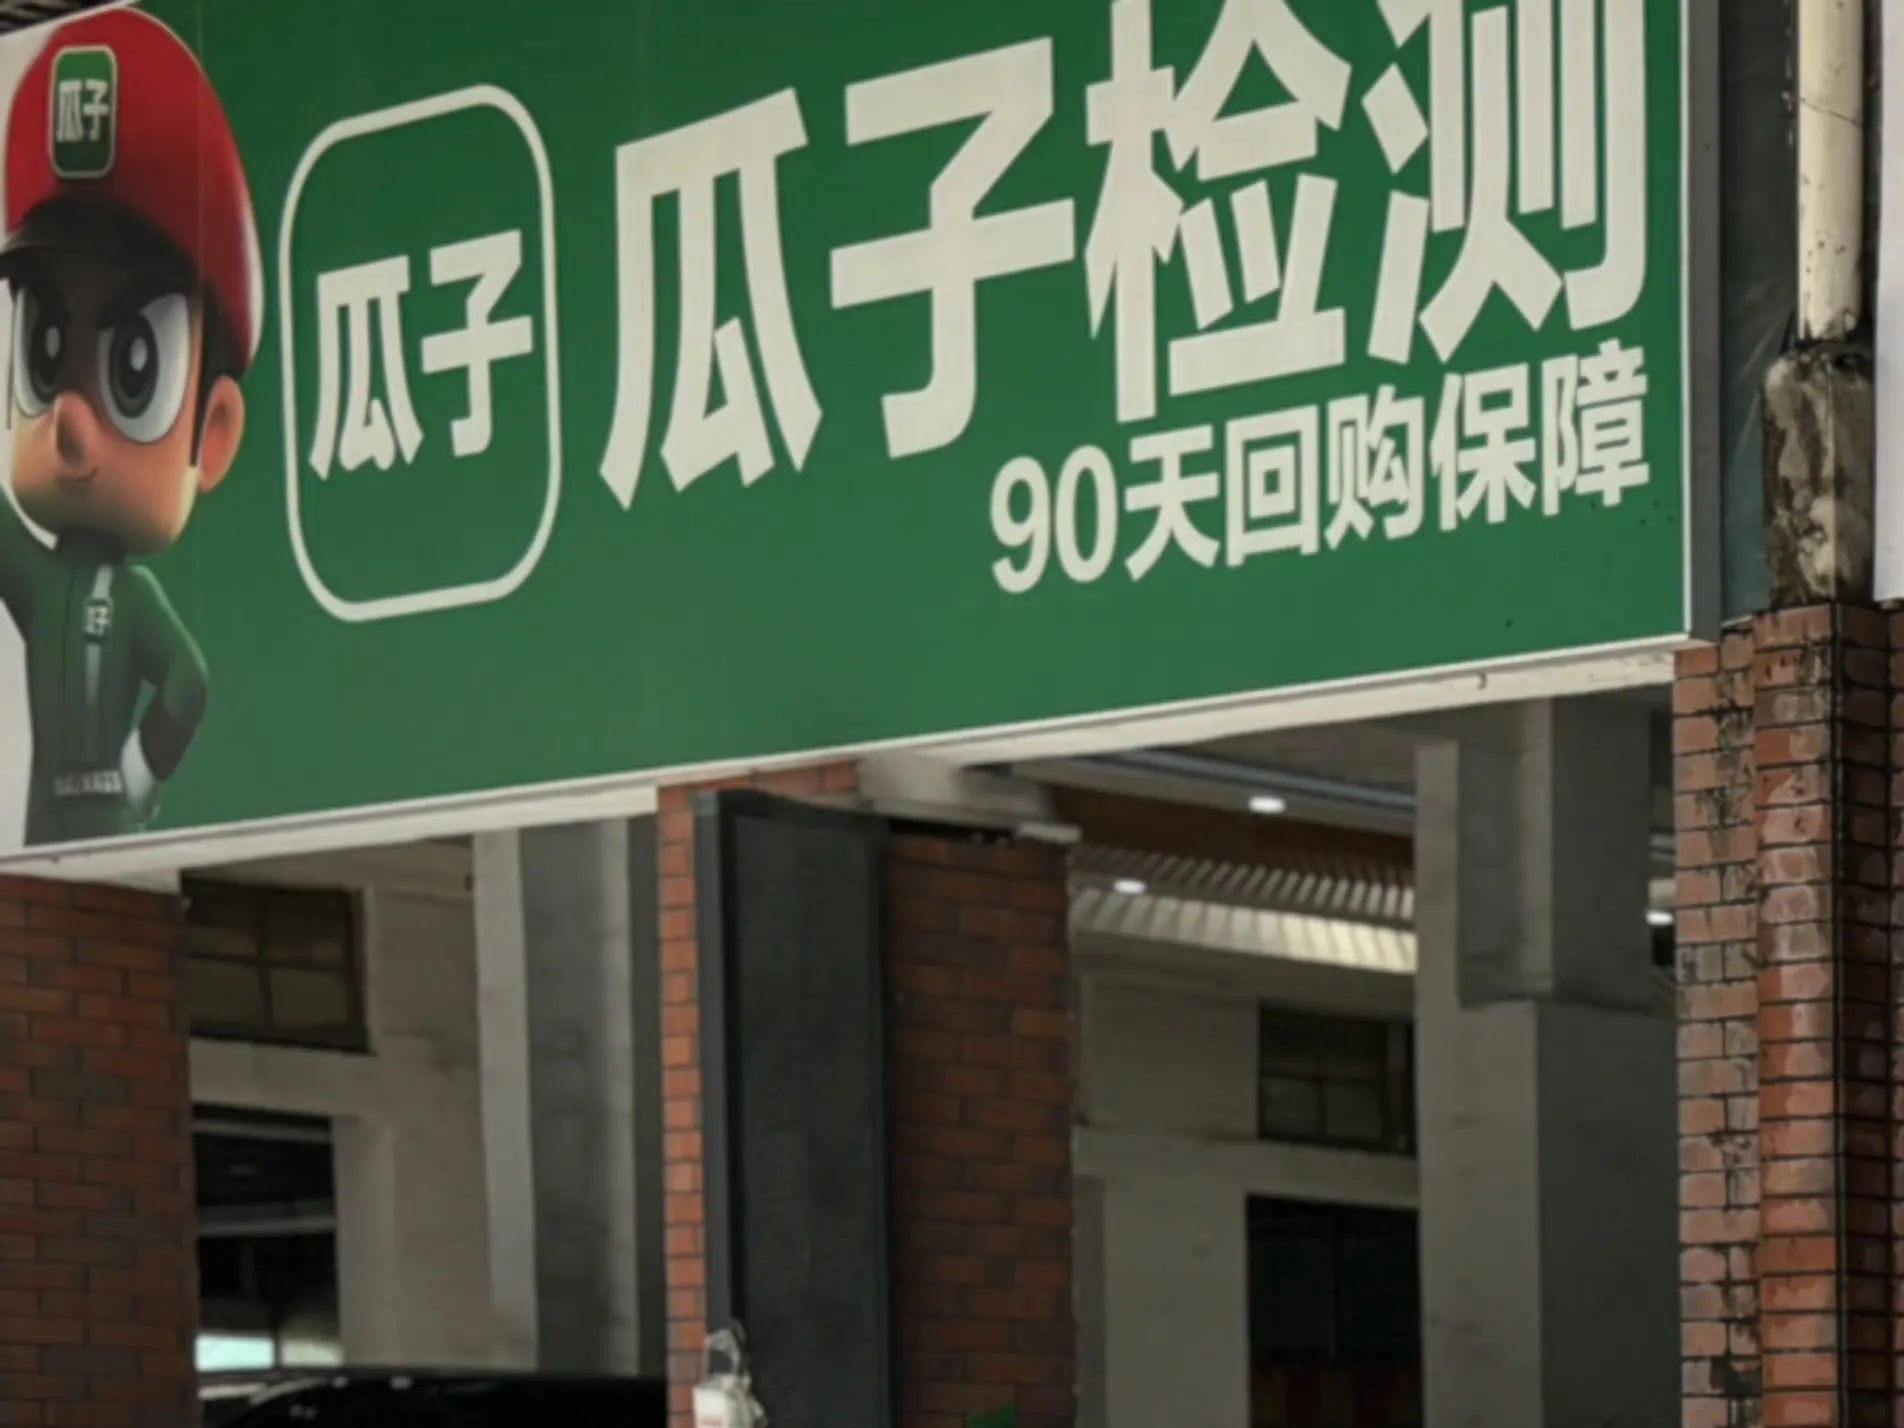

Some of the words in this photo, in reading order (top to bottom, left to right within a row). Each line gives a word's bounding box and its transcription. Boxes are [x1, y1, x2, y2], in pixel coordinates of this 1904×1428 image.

[308, 229, 533, 482] 瓜子
[599, 0, 1651, 509] 瓜子检测
[988, 339, 1652, 593] 90天回购保障
